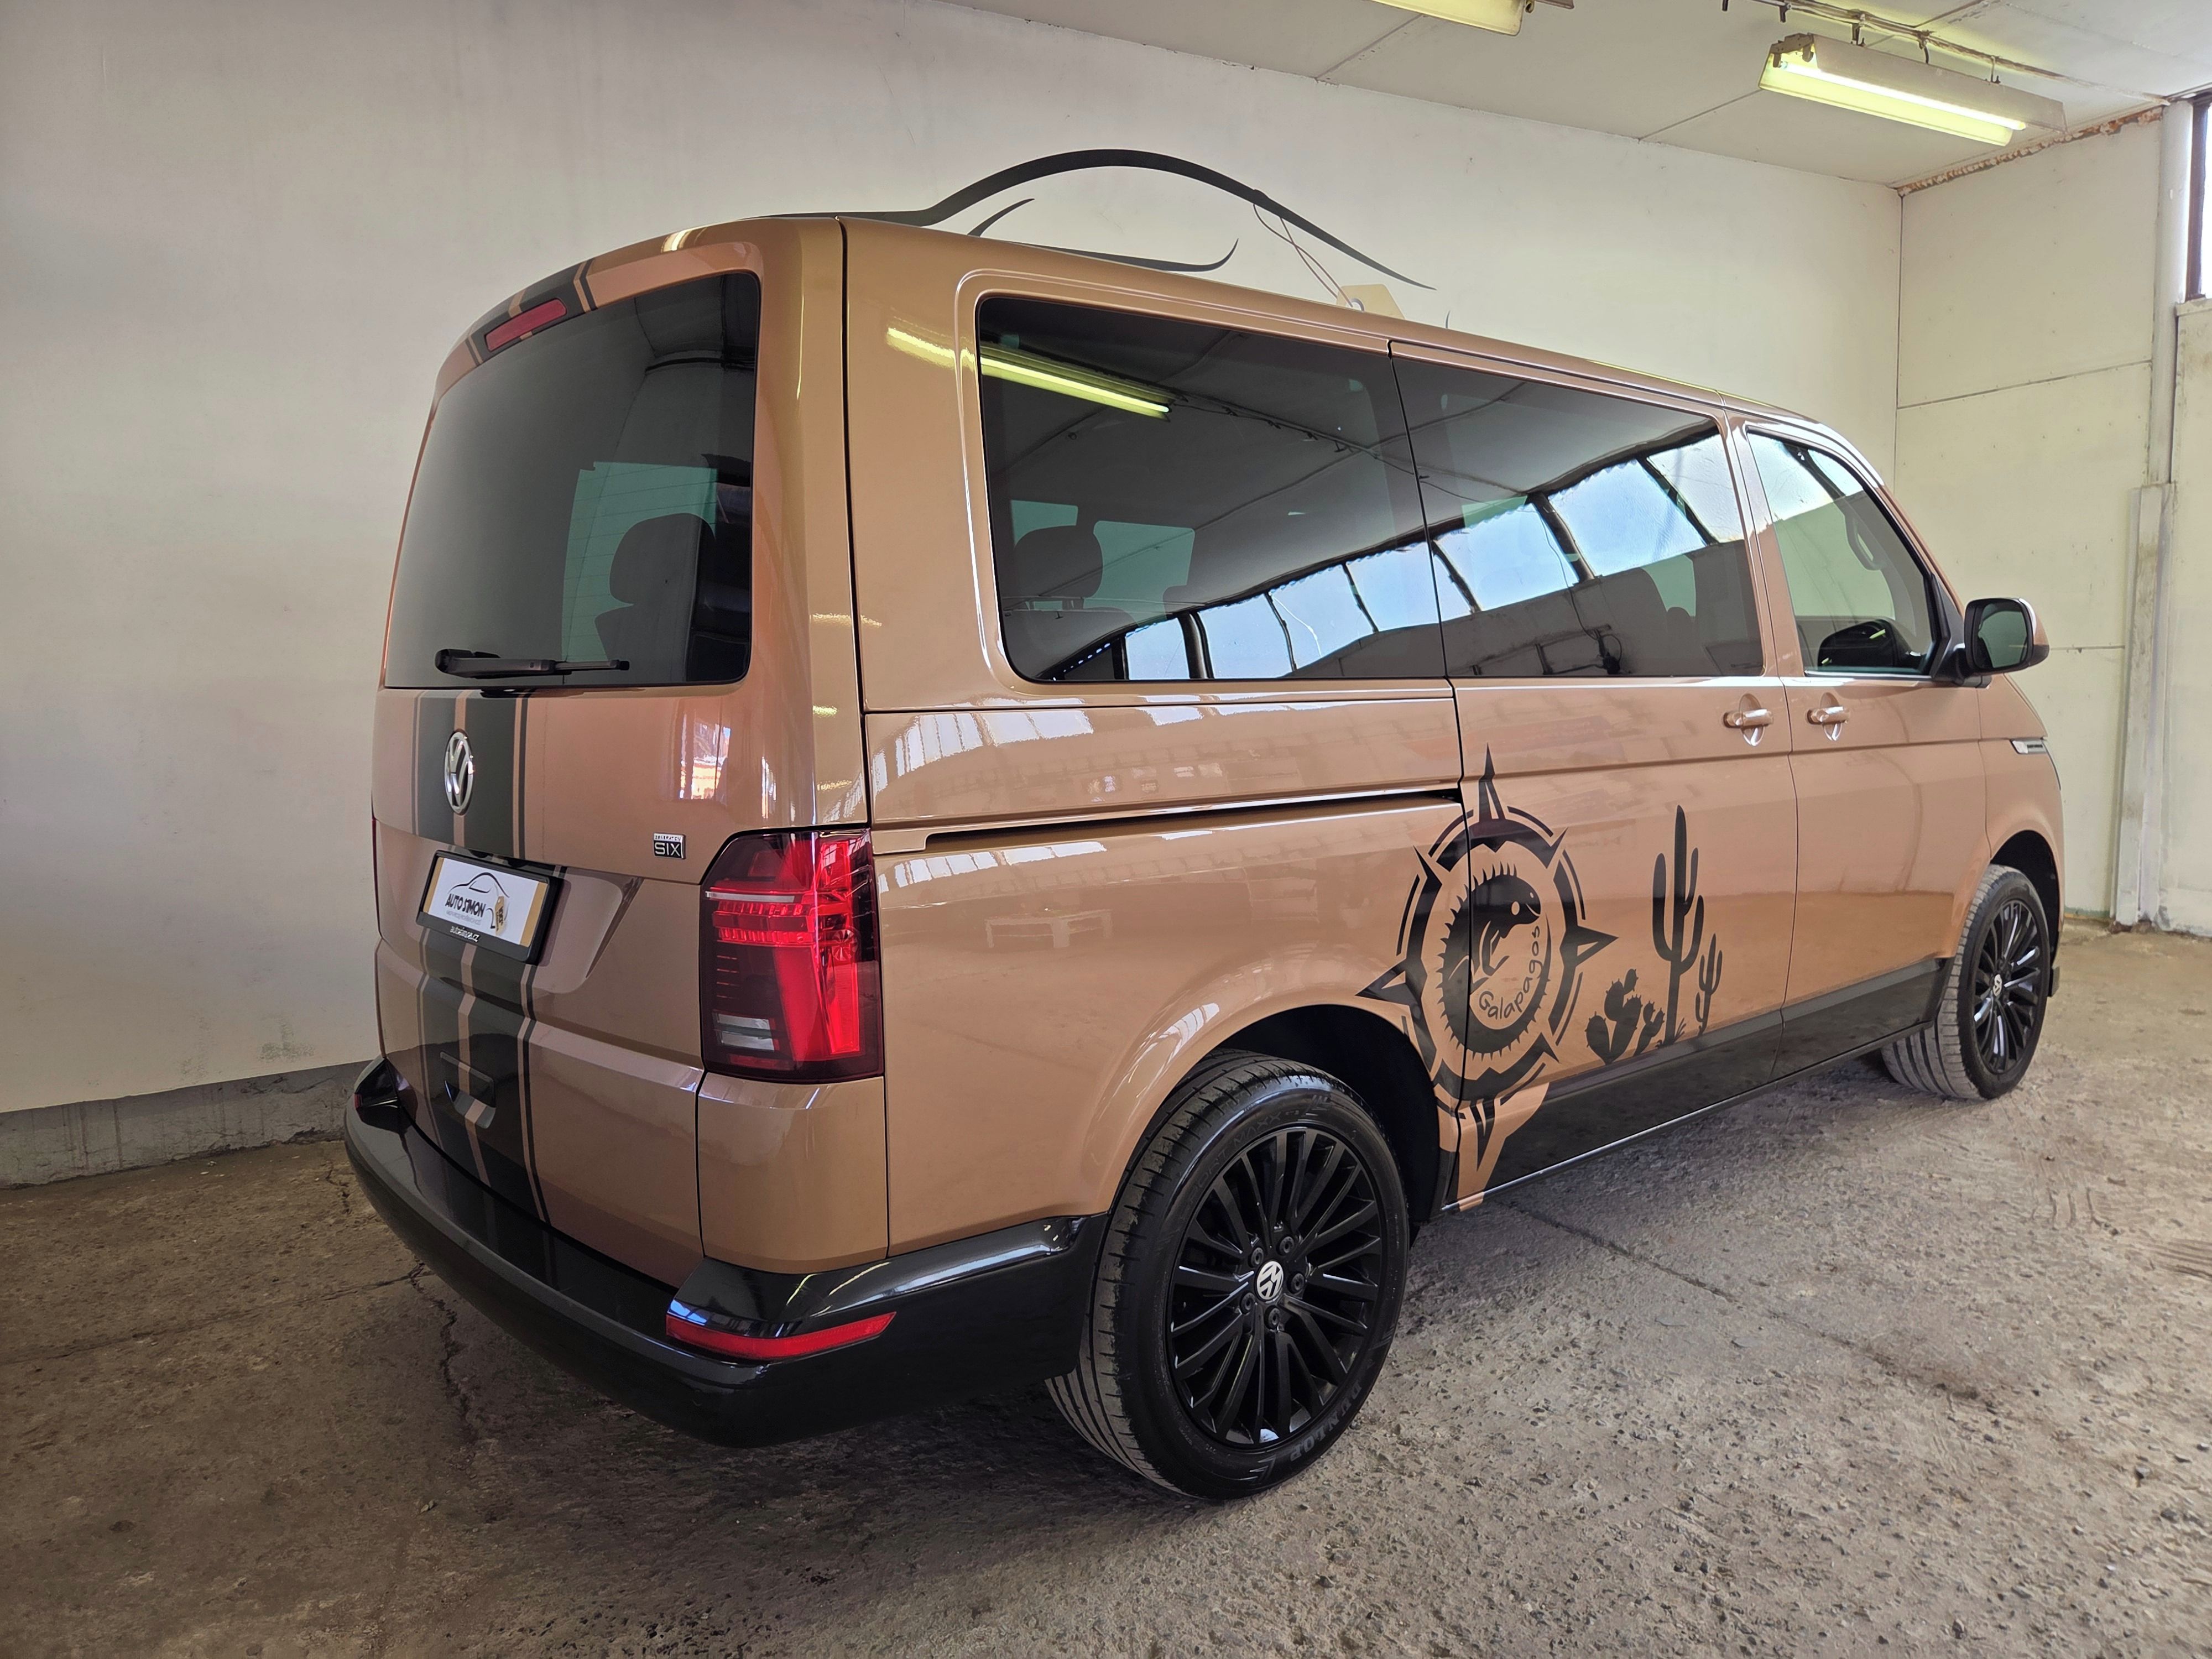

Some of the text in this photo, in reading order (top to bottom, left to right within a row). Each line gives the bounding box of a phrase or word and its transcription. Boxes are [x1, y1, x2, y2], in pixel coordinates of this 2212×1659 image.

[654, 842, 681, 857] SIX
[445, 893, 463, 910] AUTO
[462, 898, 487, 918] SIMON
[1479, 925, 1544, 1020] Galapagos
[1290, 1381, 1363, 1462] DUNLOP
